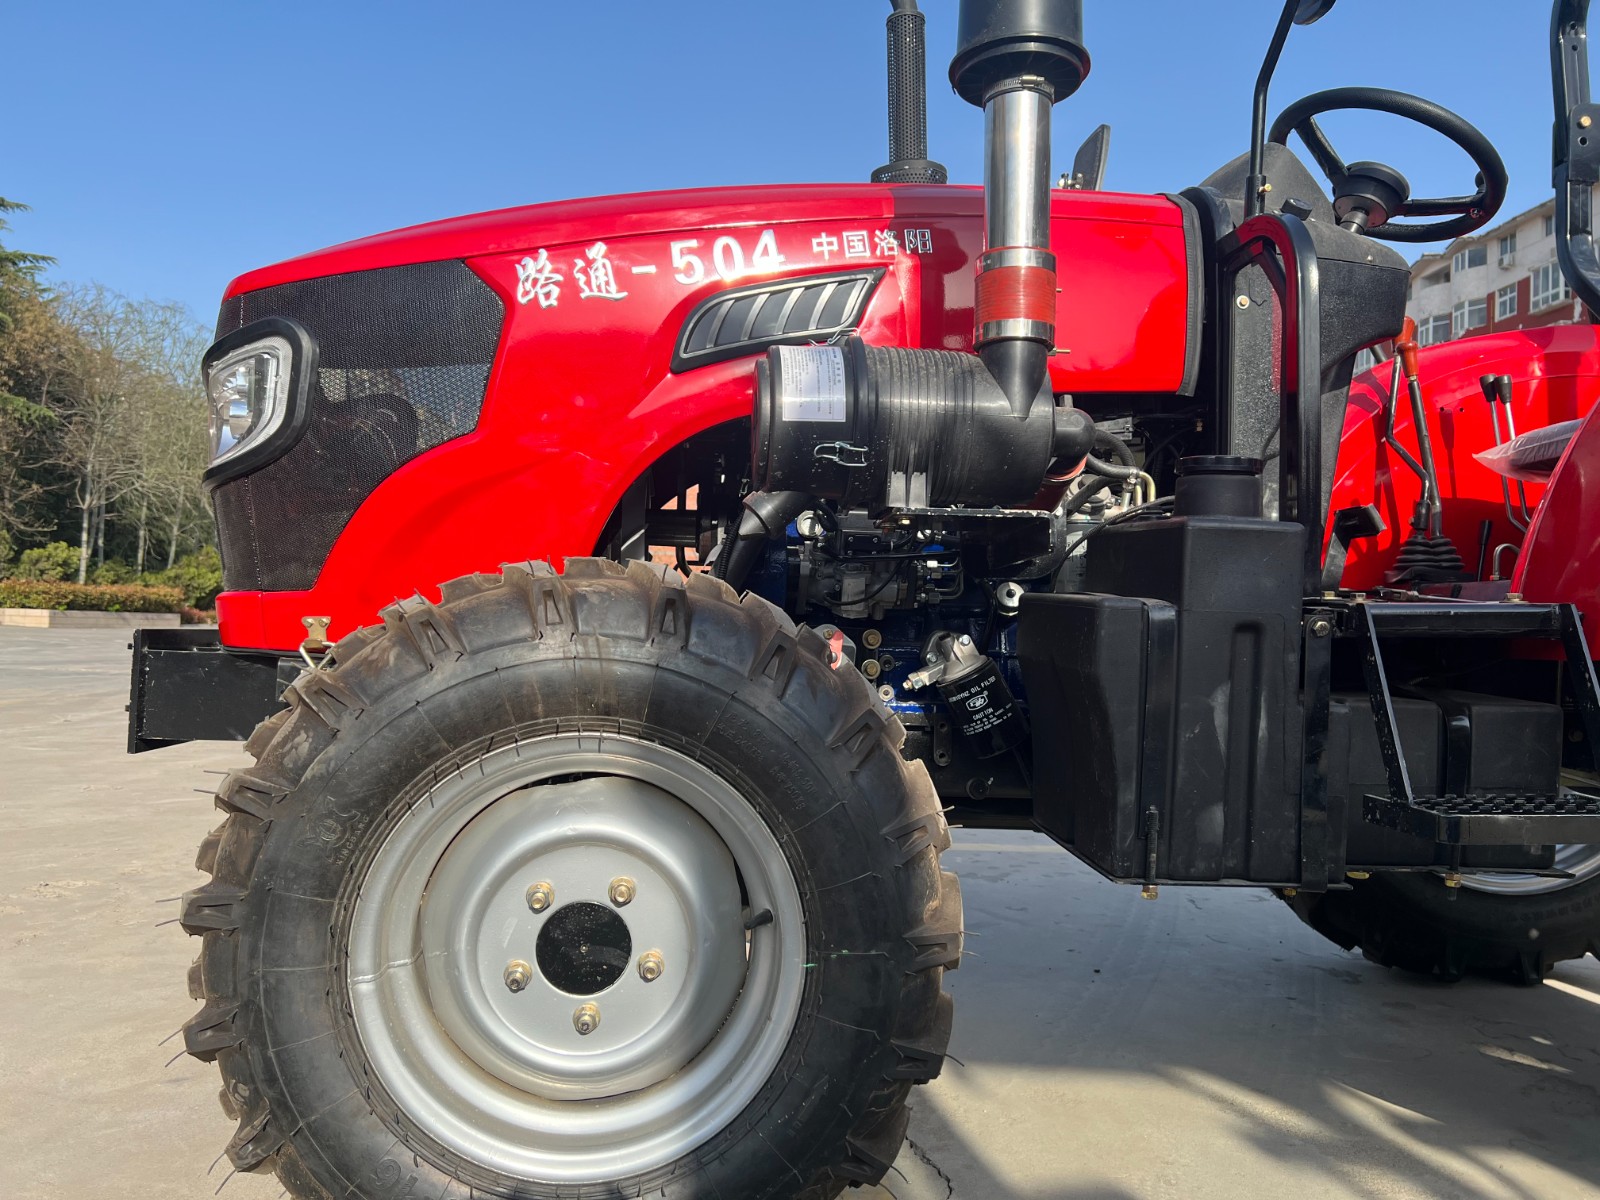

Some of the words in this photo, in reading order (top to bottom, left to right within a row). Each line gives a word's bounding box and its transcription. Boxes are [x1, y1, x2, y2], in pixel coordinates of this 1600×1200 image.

[811, 228, 933, 260] 中国洛阳
[972, 707, 994, 721] CAUTION
